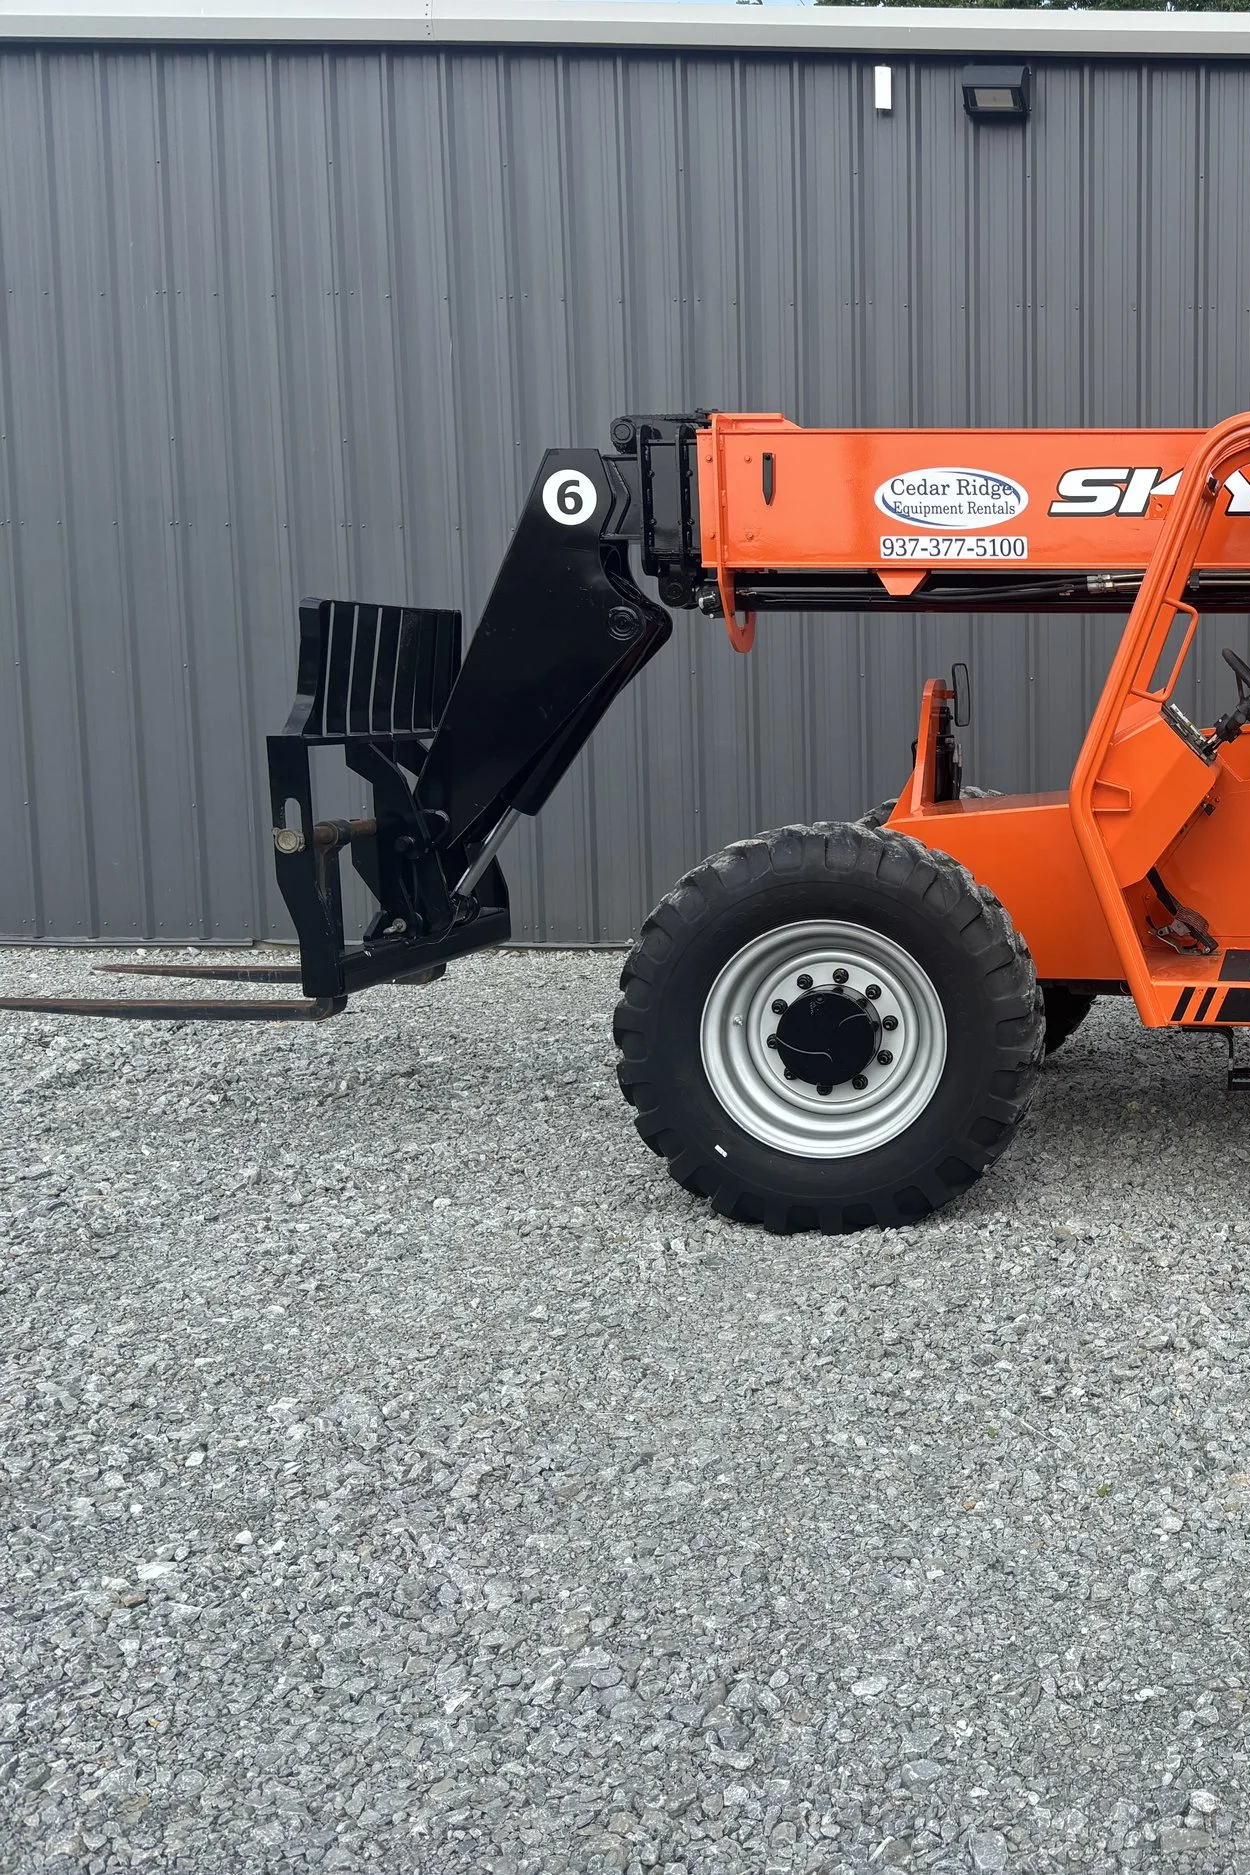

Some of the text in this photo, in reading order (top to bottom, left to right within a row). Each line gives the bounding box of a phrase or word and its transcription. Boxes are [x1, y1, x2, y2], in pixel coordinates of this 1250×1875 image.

[556, 479, 584, 516] 6
[890, 478, 1014, 500] Cedar Ridge
[893, 501, 1016, 517] Equipment Rentals
[882, 538, 1025, 557] 937-377-5100
